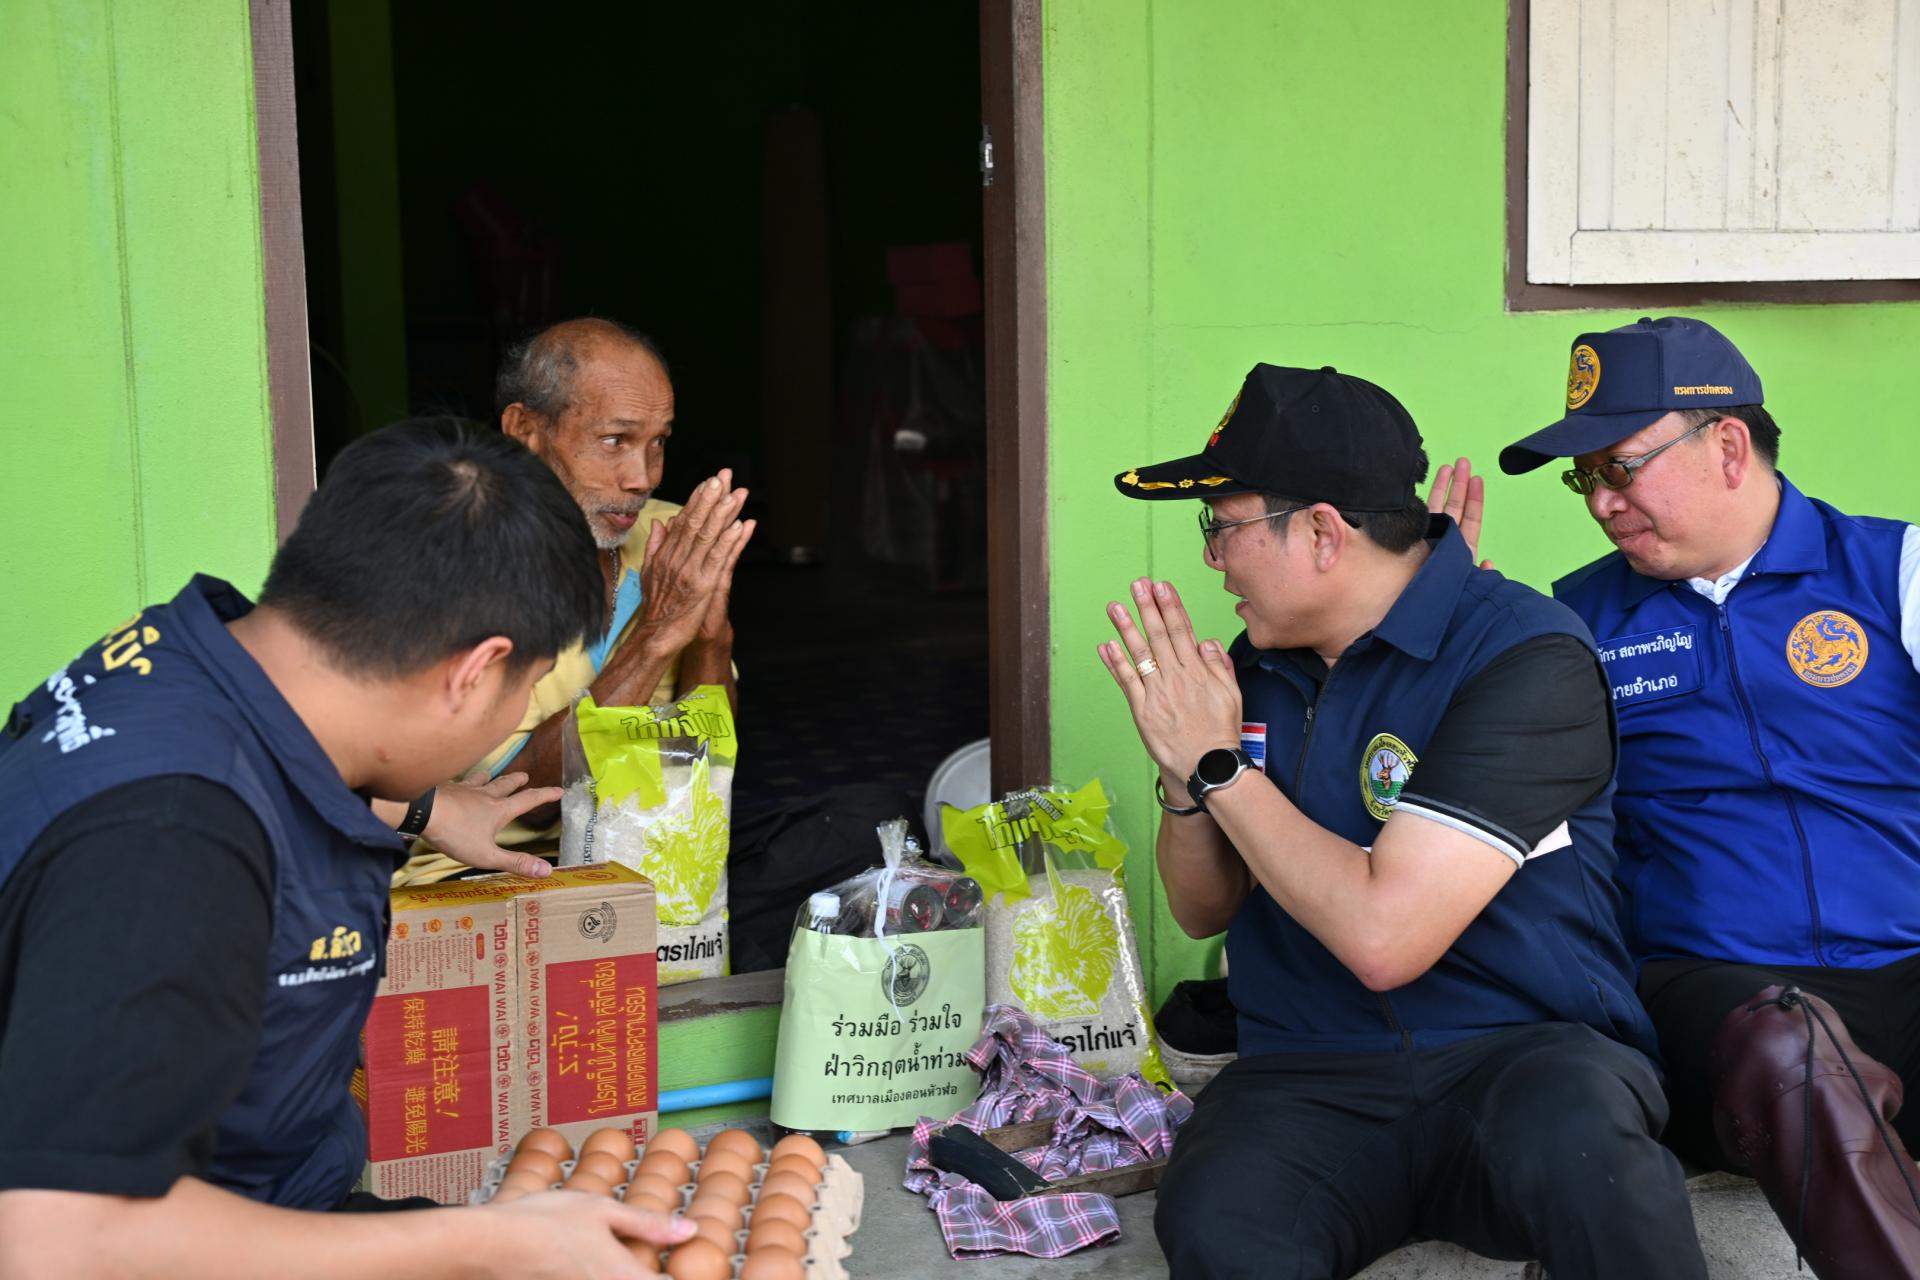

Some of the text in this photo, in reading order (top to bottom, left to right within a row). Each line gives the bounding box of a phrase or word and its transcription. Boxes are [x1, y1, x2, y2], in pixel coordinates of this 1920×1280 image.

[1619, 631, 1692, 658] สถาพรภิญโญ
[494, 919, 508, 950] ไวไว
[525, 918, 539, 949] ไวไว
[496, 971, 506, 1021] WAI WAI
[530, 968, 540, 1019] WAI WAI
[831, 1003, 962, 1037] ร่วมมือ ร่วมใจ
[527, 1039, 541, 1070] ไวไว
[618, 986, 648, 1107] แสงแดดและความร้อน
[1053, 1023, 1137, 1053] ราไก่แจ้
[497, 1040, 511, 1072] ไวไว
[824, 1042, 968, 1080] ฝ่าวิกฤตน้ำท่วม
[498, 1091, 509, 1142] WAI WAI
[530, 1088, 542, 1130] AI WAI
